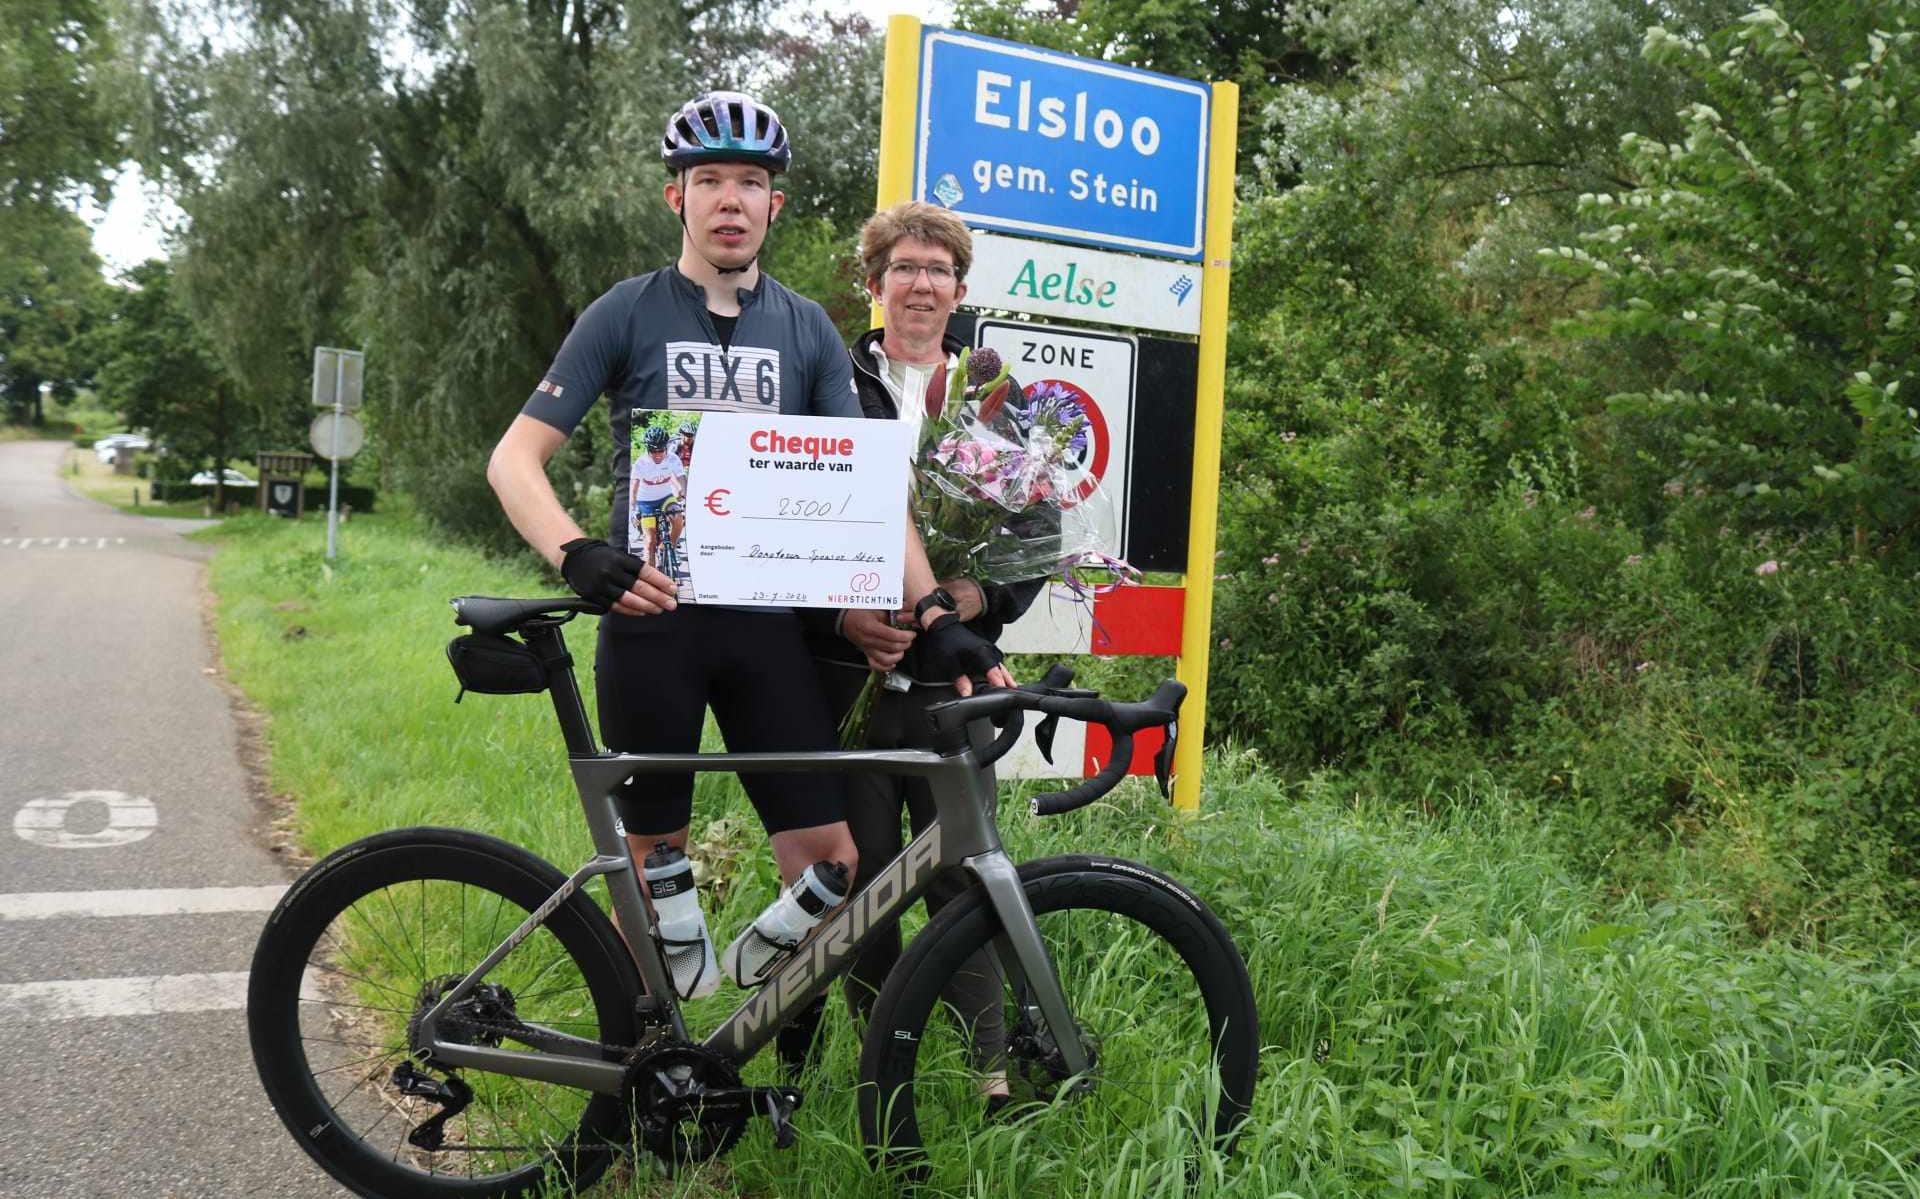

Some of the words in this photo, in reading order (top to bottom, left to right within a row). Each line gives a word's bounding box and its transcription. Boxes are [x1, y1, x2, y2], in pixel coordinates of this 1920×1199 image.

[975, 70, 1160, 155] Elsloo
[973, 159, 1055, 193] gem.
[1069, 168, 1157, 212] Stein
[1008, 259, 1117, 308] Aelse
[1022, 342, 1095, 369] ZONE
[674, 351, 743, 402] SIX
[756, 358, 776, 406] 6
[750, 430, 854, 460] Cheque
[749, 458, 768, 470] ter
[774, 458, 825, 472] waarde
[829, 461, 853, 472] van
[704, 488, 732, 516] €
[828, 595, 898, 605] NIERSTICHTING
[734, 823, 942, 1050] MERIDA
[894, 1030, 919, 1042] SL
